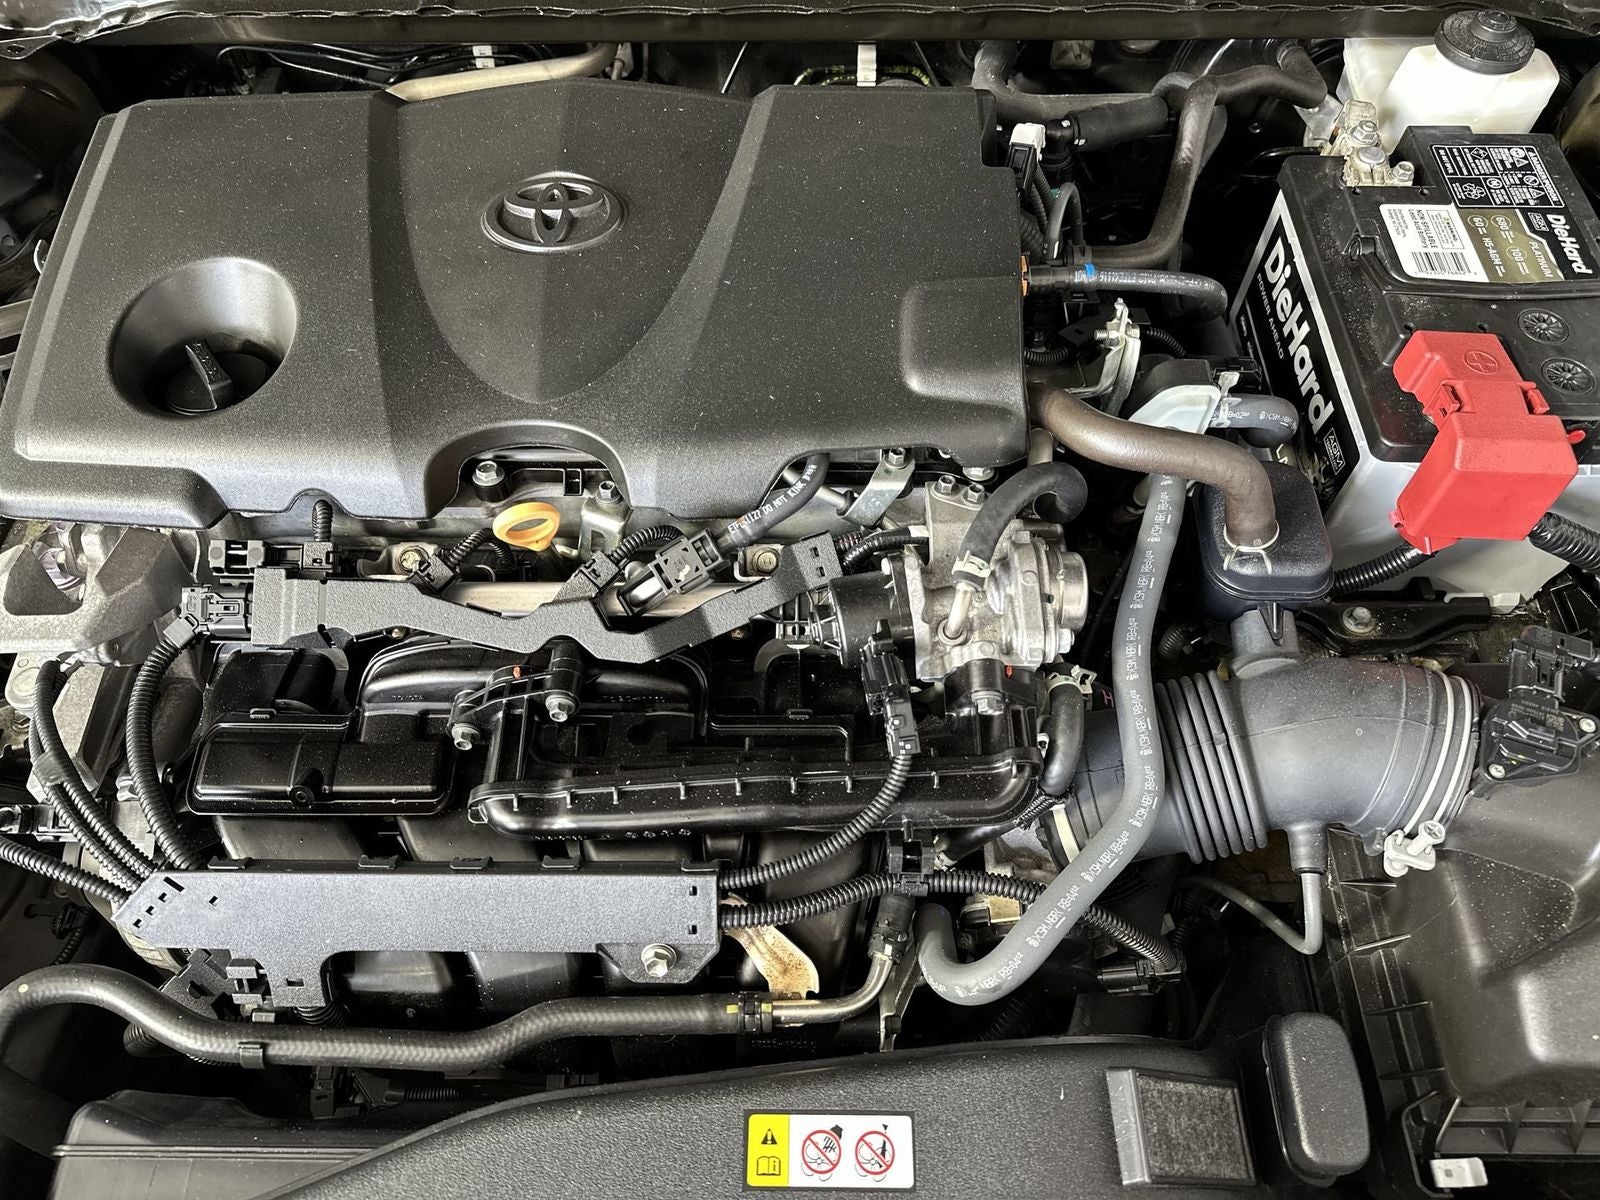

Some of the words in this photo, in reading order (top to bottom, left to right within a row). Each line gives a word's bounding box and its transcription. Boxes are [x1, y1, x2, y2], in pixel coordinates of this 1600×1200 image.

[1473, 217, 1484, 227] 60
[1496, 217, 1509, 230] 680
[1511, 248, 1524, 262] 100
[1529, 241, 1554, 278] PLATINUM
[1546, 214, 1593, 274] DieHard
[1257, 273, 1271, 316] POWER
[1268, 317, 1284, 359] AHEAD
[1264, 236, 1335, 435] DieHard
[1328, 435, 1343, 468] AGM
[762, 503, 774, 515] DO
[772, 494, 788, 508] NOT
[786, 480, 806, 498] KINK
